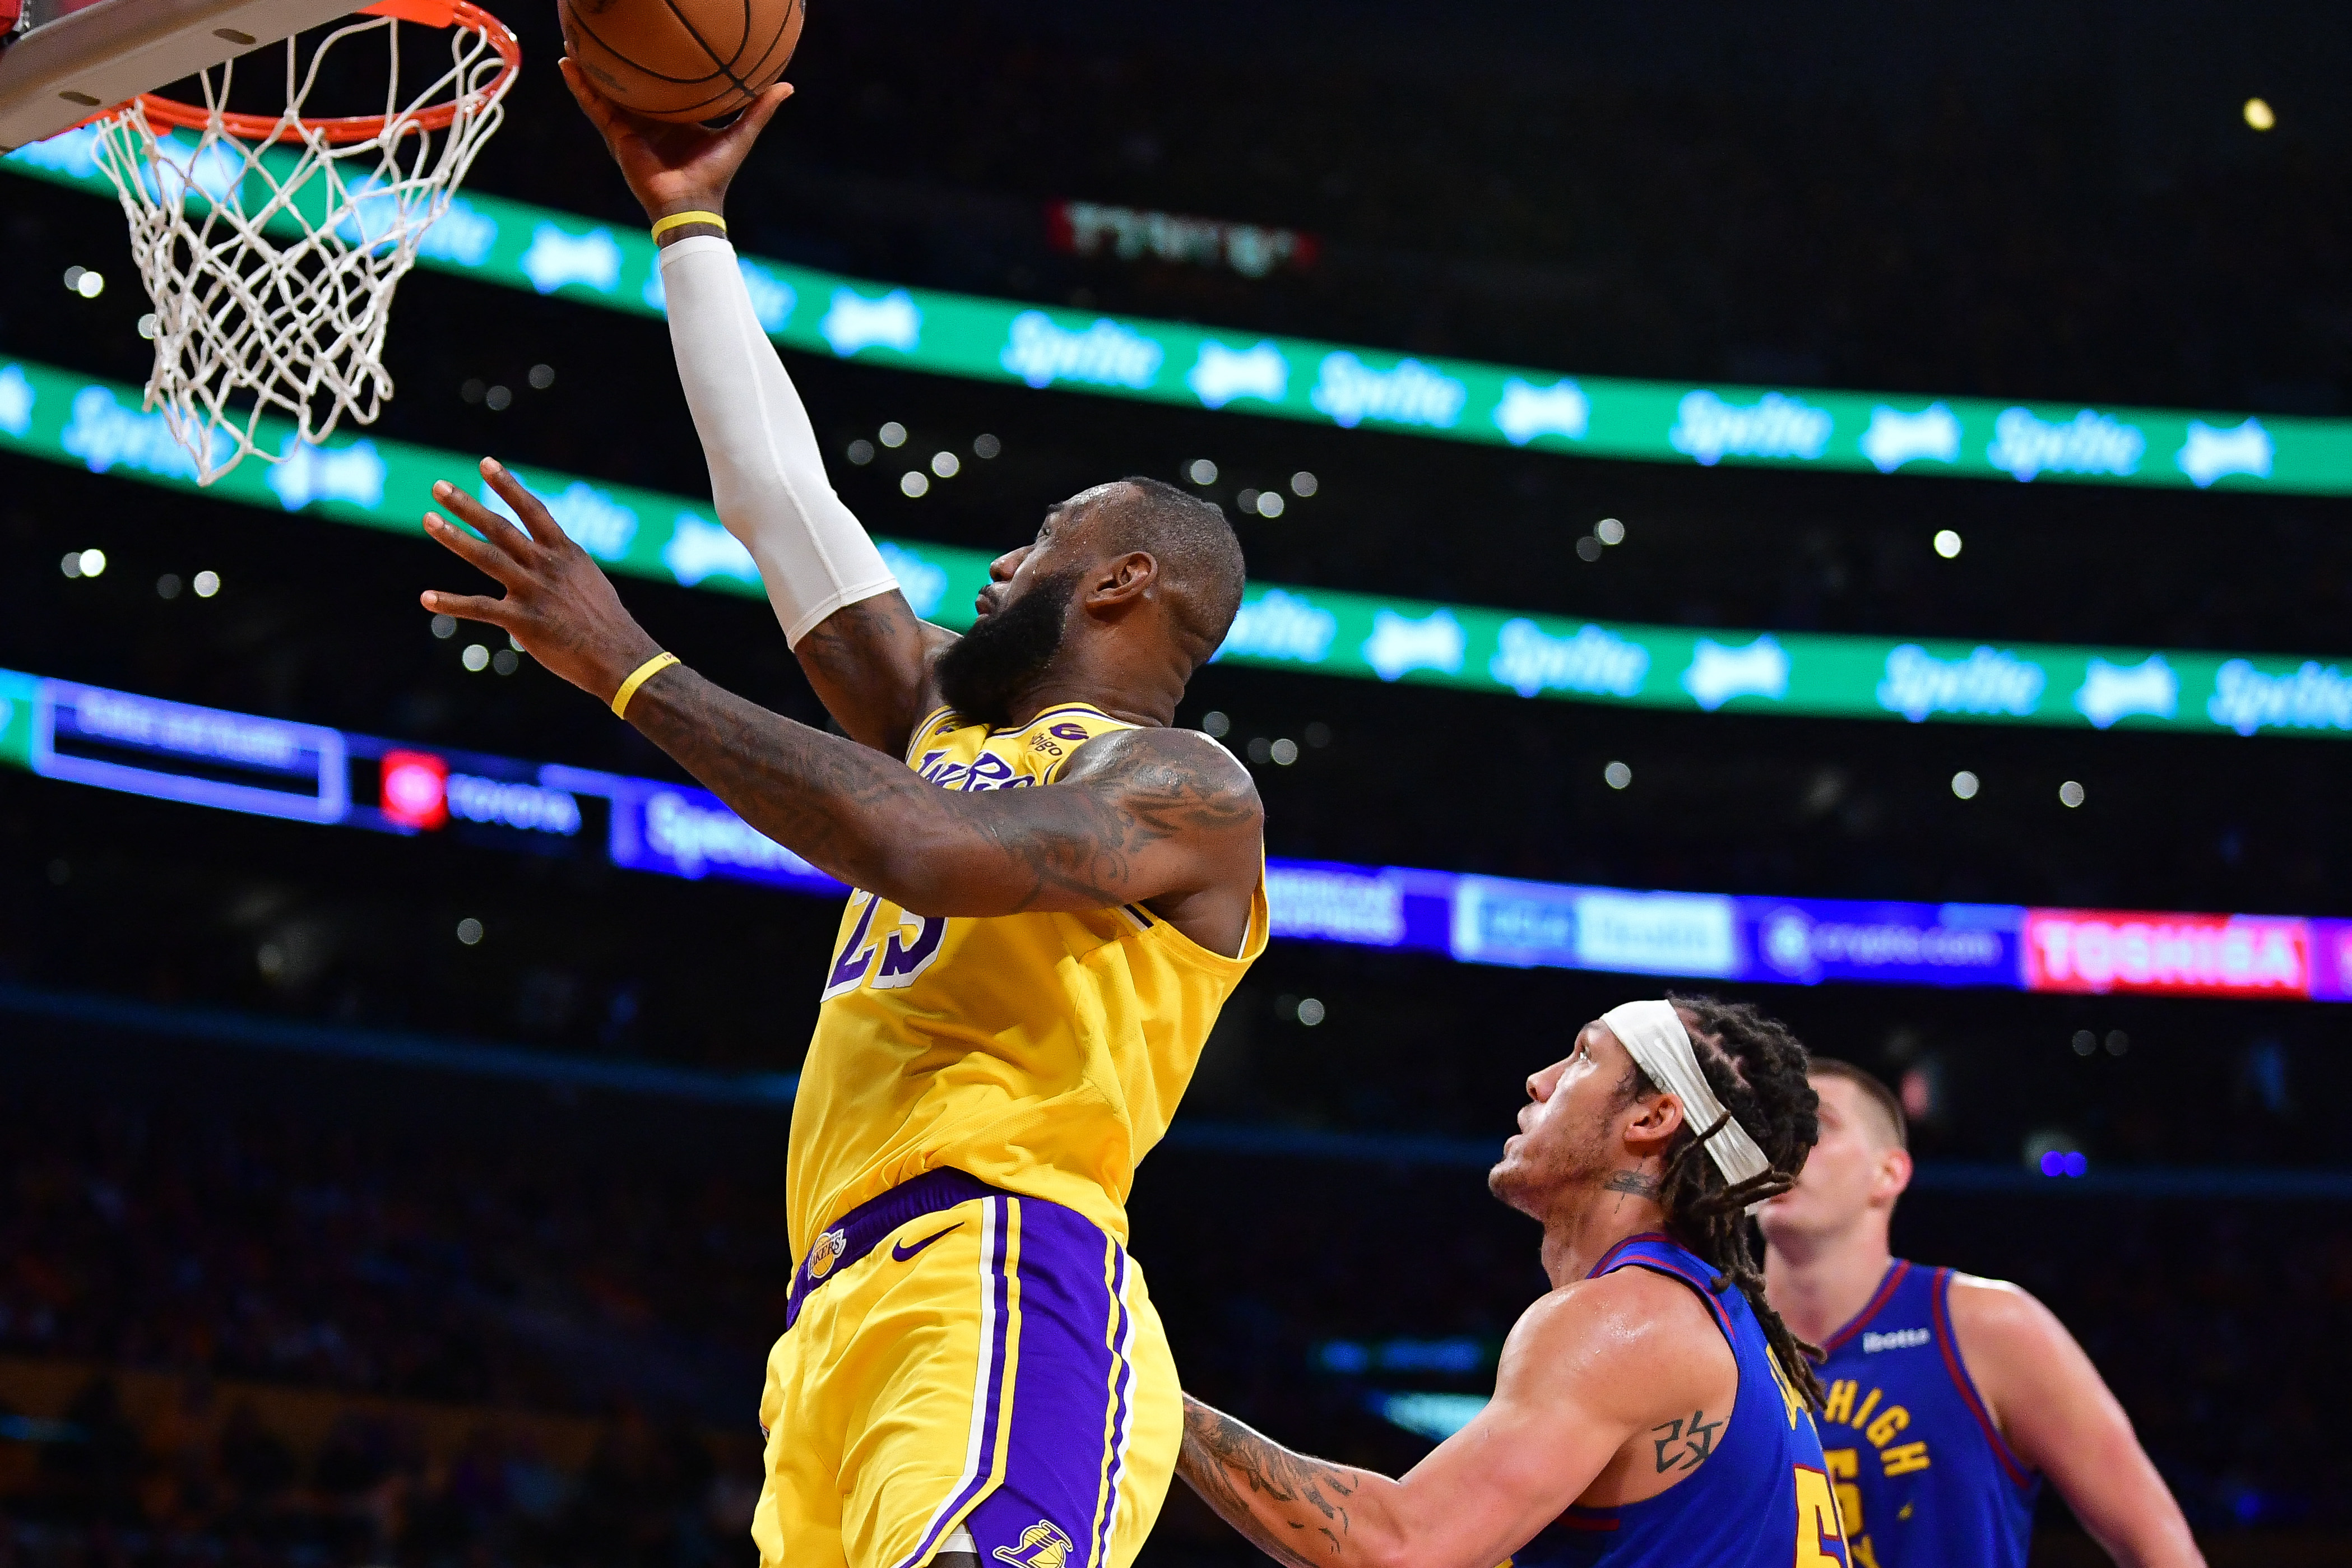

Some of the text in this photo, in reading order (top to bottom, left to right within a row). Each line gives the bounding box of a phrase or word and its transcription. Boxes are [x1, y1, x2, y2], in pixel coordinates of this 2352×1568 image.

[999, 310, 1166, 389] Sprite
[1310, 350, 1468, 428] Sprite
[1668, 389, 1834, 466] Sprite
[1988, 407, 2147, 482] Sprite
[1489, 618, 1651, 697] Sprite
[1876, 644, 2047, 722] Sprite
[2034, 920, 2303, 987] TOSHIBA
[1824, 1379, 1932, 1478] HIGH
